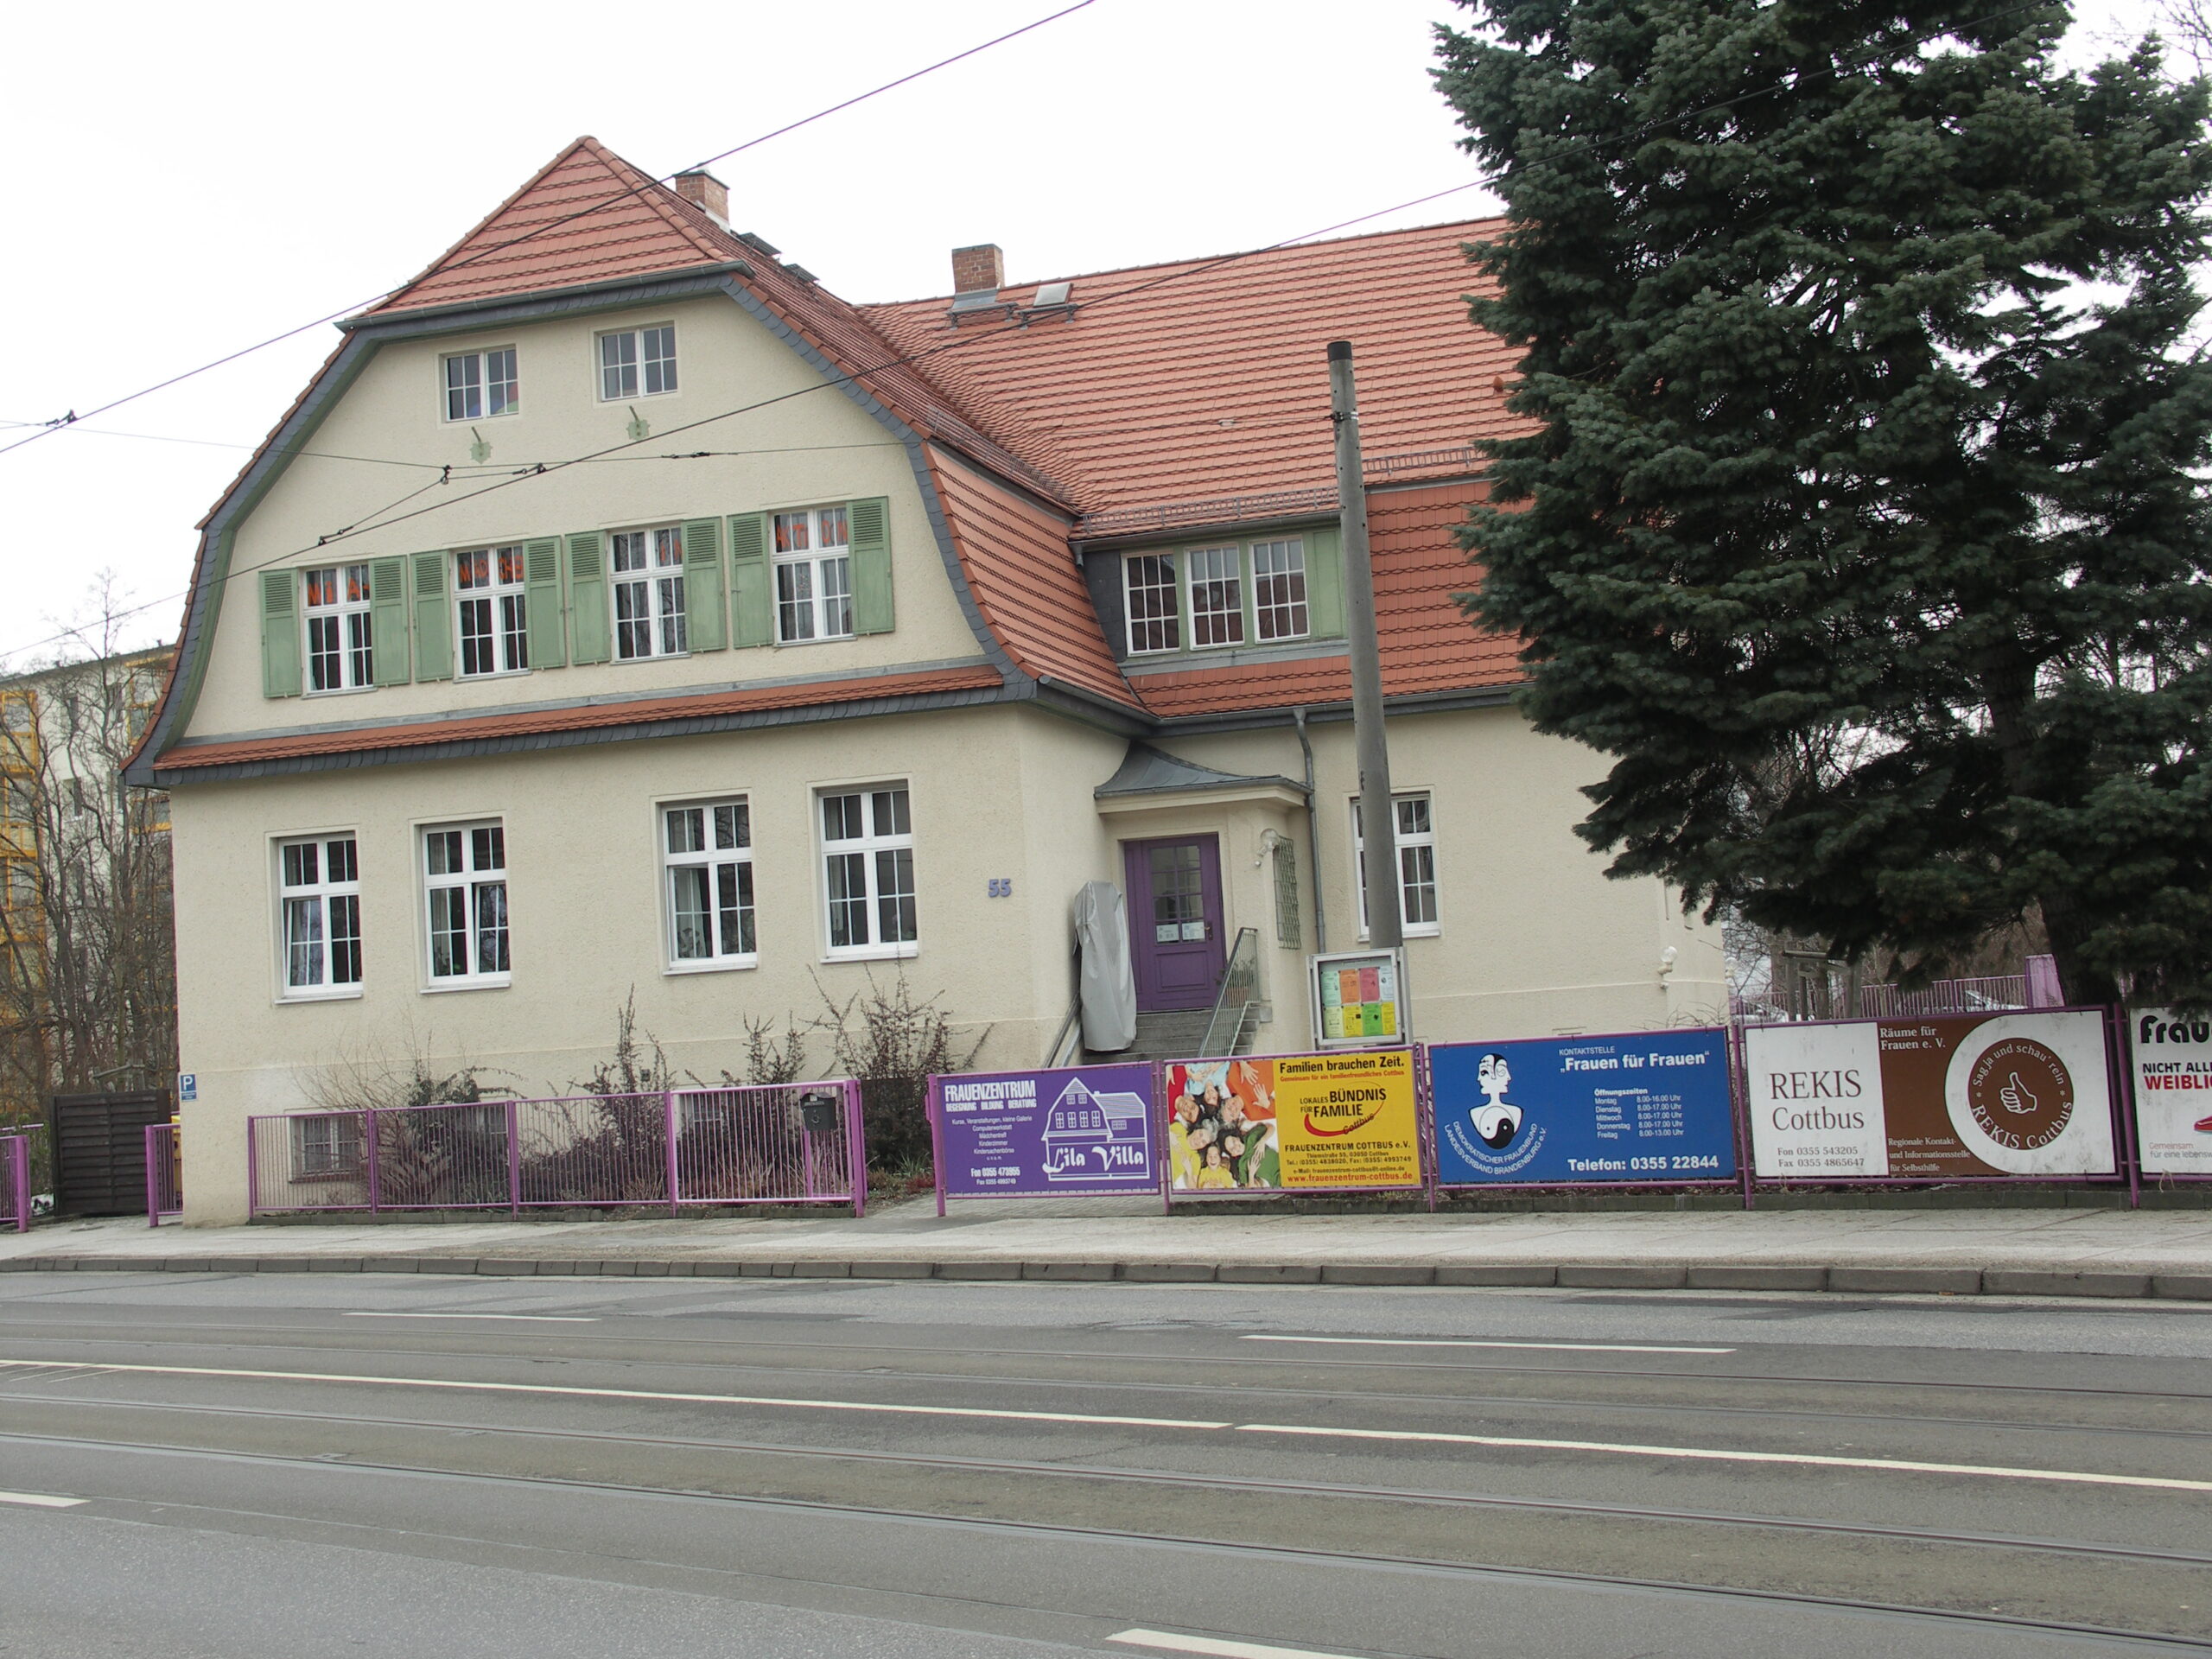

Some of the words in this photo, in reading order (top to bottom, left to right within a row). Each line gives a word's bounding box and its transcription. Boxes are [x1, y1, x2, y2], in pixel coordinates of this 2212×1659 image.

[988, 878, 1011, 897] 55
[1880, 1027, 1917, 1039] Räume
[1920, 1026, 1936, 1036] für
[1559, 1046, 1615, 1056] KONTAKTSTELLE
[1880, 1040, 1918, 1051] Frauen
[1922, 1040, 1932, 1049] e.
[1936, 1038, 1946, 1048] V.
[1280, 1061, 1323, 1073] Familien
[1327, 1056, 1376, 1071] brauchen
[1379, 1055, 1404, 1068] Zeit.
[1623, 1055, 1645, 1068] für
[1972, 1066, 1989, 1087] Sag
[1993, 1044, 2013, 1059] und
[2049, 1063, 2064, 1084] rein
[2143, 1063, 2181, 1073] NICHT
[183, 1076, 193, 1090] P
[1770, 1069, 1861, 1100] REKIS
[944, 1080, 1036, 1102] FRAUENZENTRUM
[1330, 1088, 1387, 1103] BÜNDNIS
[1007, 1098, 1037, 1109] BERATUNG
[1300, 1105, 1313, 1114] FÜR
[1313, 1103, 1363, 1118] FAMILIE
[1342, 1112, 1376, 1135] Cottbus
[1772, 1105, 1865, 1130] Cottbus
[1972, 1104, 2020, 1149] REKIS
[2026, 1102, 2072, 1149] Cottbus
[1285, 1142, 1354, 1153] FRAUENZENTRUM
[1356, 1141, 1394, 1150] COTTBUS
[1395, 1141, 1411, 1149] e.V.
[1444, 1124, 1493, 1174] LANDESVERBAND
[1494, 1141, 1541, 1174] BRANDENBURG
[1453, 1121, 1503, 1164] DEMOKRATISCHER
[1504, 1123, 1537, 1162] FRAUENBUND
[1888, 1138, 1923, 1147] Regionale
[1796, 1147, 1820, 1155] 0355
[1822, 1146, 1858, 1155] 543205
[1091, 1146, 1144, 1172] Villa
[1567, 1159, 1626, 1171] Telefon:
[1630, 1157, 1667, 1169] 0355
[1672, 1155, 1719, 1169] 22844
[1797, 1158, 1821, 1166] 0355
[1823, 1158, 1865, 1166] 4865647
[970, 1167, 981, 1177] Fon
[1287, 1172, 1413, 1183] www.frauenzentrum-cottbus.de
